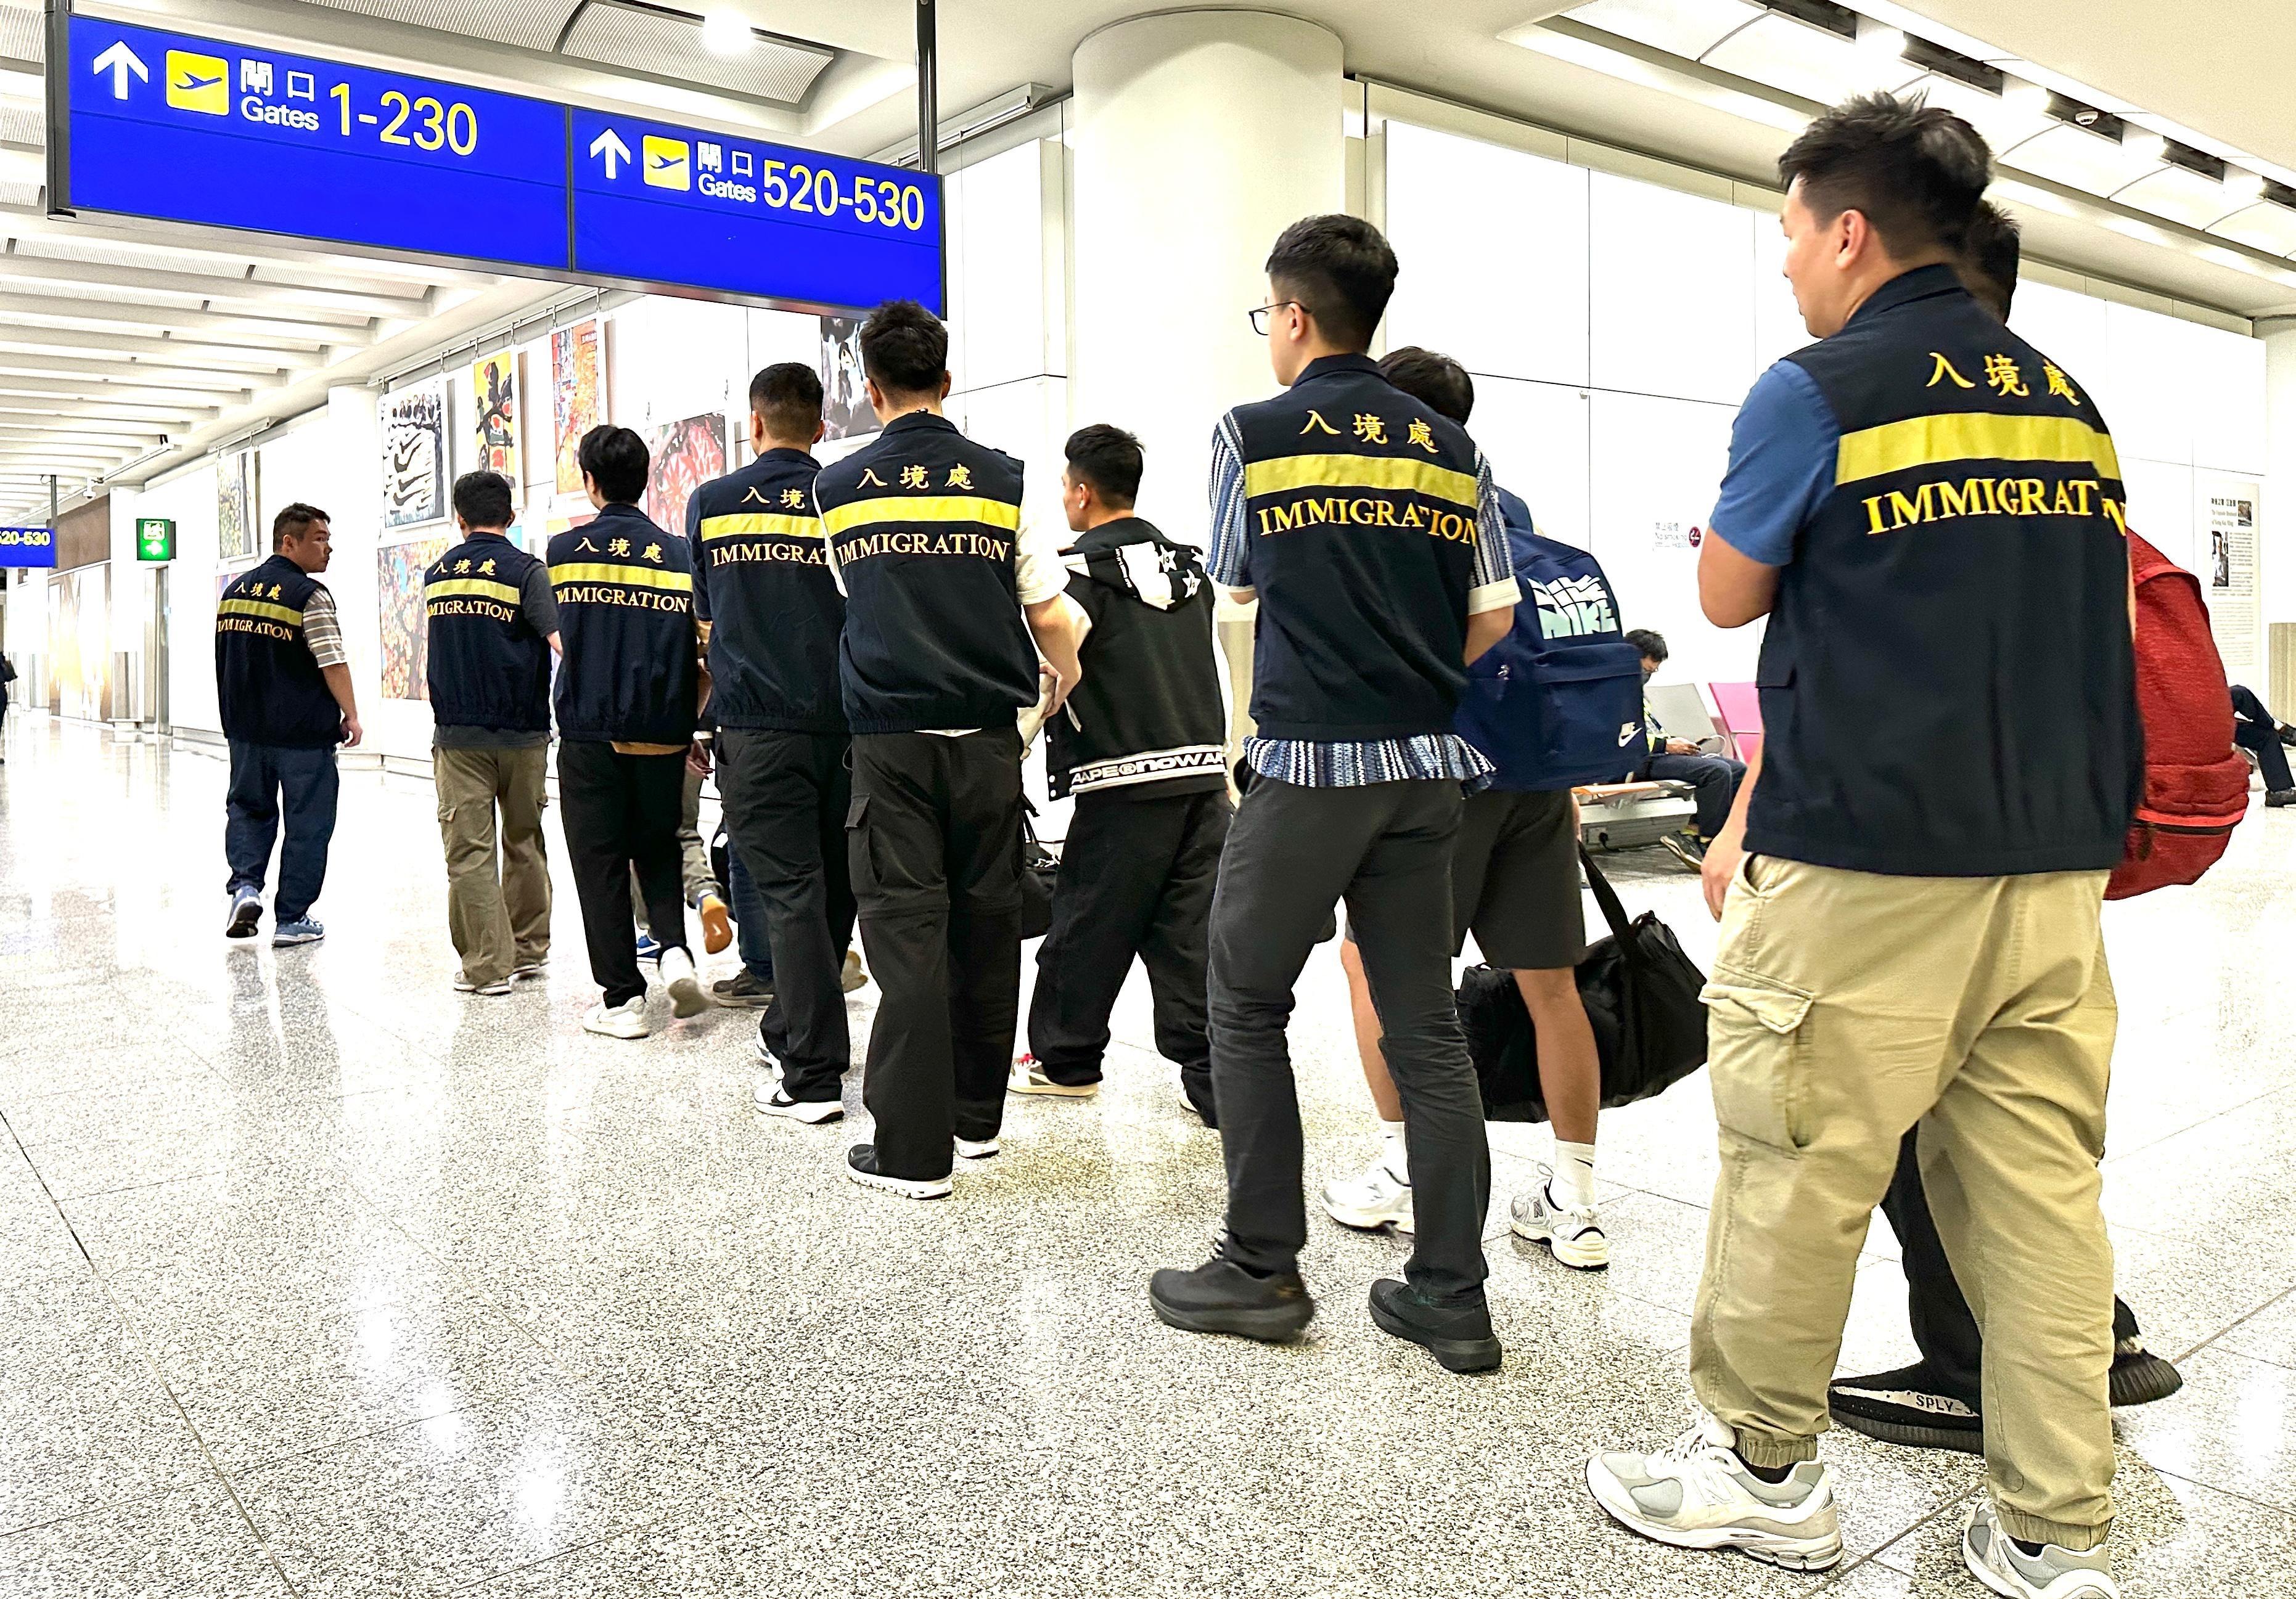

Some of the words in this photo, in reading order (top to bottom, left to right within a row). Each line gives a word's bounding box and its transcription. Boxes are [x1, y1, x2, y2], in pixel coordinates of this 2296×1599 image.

[240, 58, 315, 103] 閘口
[240, 95, 320, 132] Gates
[329, 82, 478, 157] 1-230
[697, 141, 754, 178] 閘口
[697, 173, 756, 203] Gates
[763, 159, 925, 231] 520-530
[1925, 351, 2081, 406] 入境處
[1299, 409, 1440, 454] 入境處
[856, 462, 975, 490] 入境處
[740, 486, 806, 509] 入境
[574, 537, 663, 563] 入境處
[835, 533, 1011, 567] IMMIGRATION
